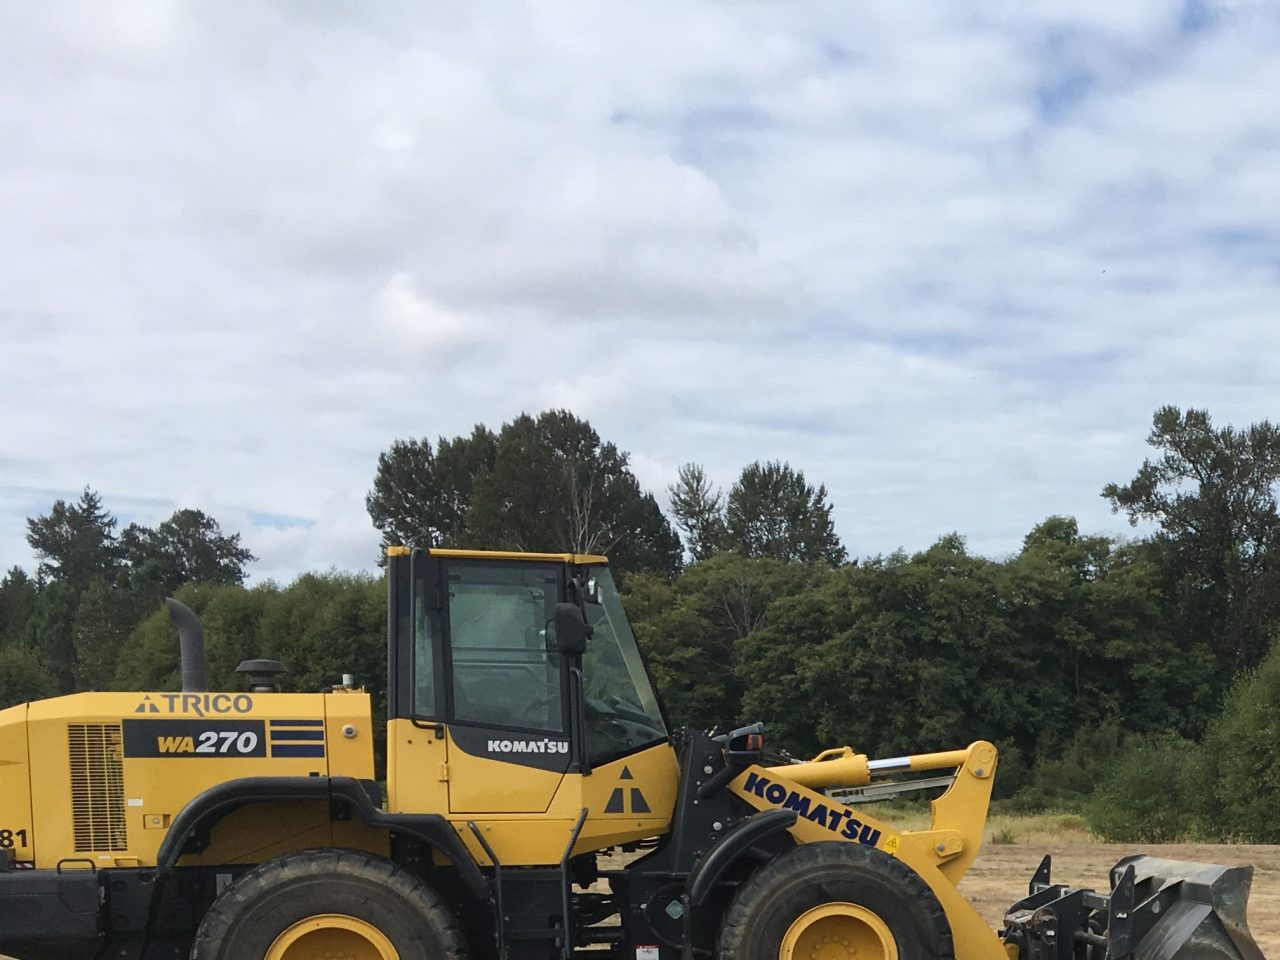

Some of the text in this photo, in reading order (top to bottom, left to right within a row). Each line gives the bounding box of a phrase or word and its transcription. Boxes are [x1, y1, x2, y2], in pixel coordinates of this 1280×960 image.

[160, 694, 253, 717] TRICO
[157, 731, 258, 753] WA270
[487, 738, 569, 753] KOMATSU
[743, 772, 882, 848] KOMATSU
